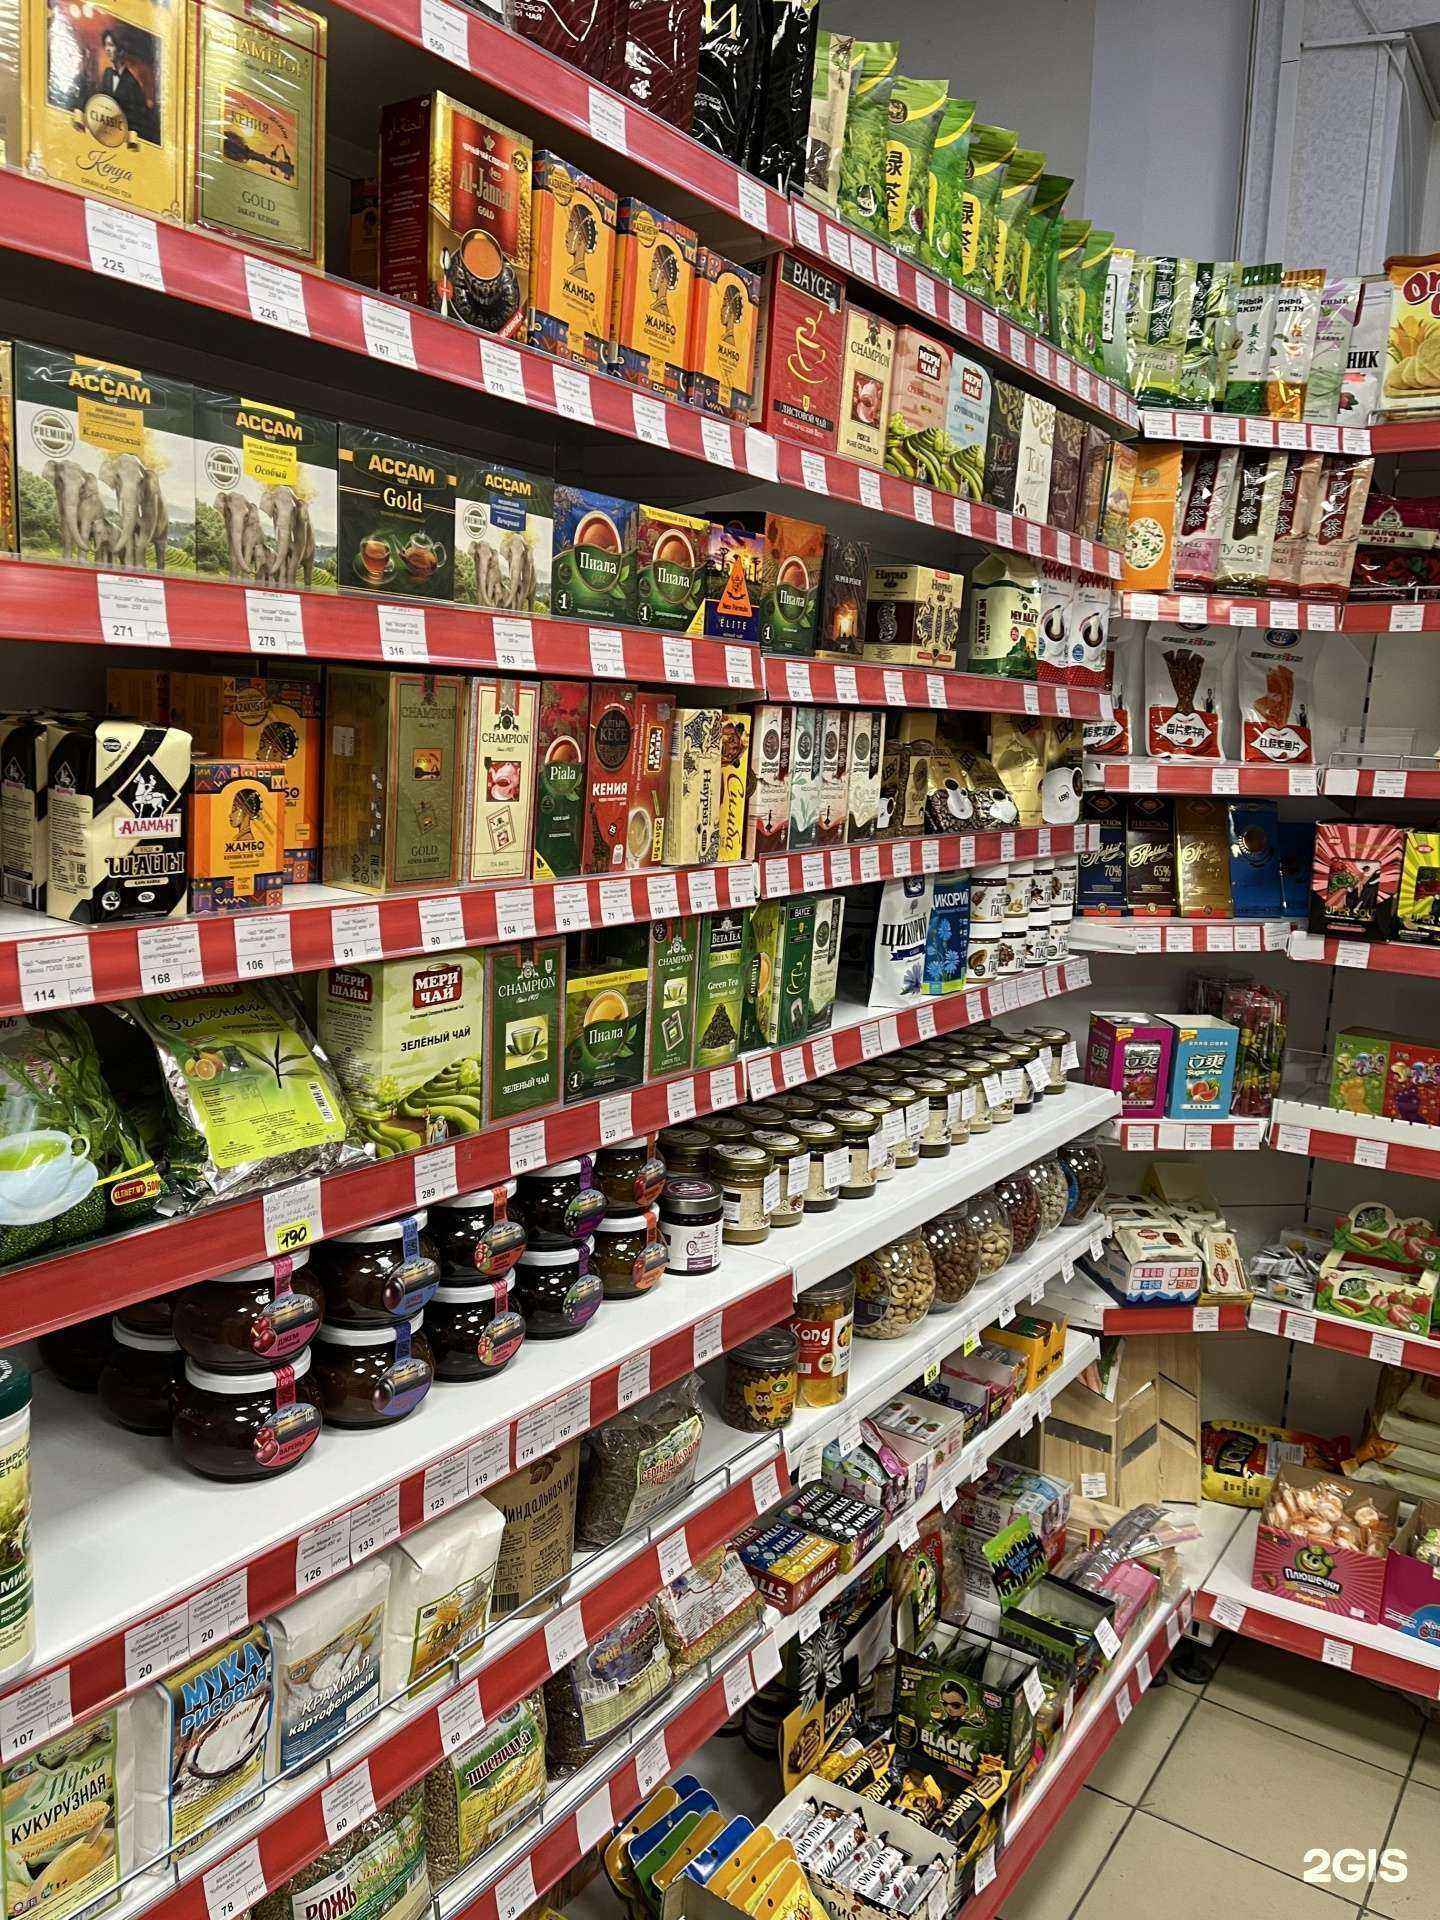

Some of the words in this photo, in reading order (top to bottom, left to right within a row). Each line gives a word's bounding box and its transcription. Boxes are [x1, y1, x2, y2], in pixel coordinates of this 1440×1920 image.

[76, 150, 135, 182] Kenya
[242, 190, 275, 213] GOLD
[101, 256, 126, 274] 225
[793, 263, 833, 299] BAYCE
[562, 278, 596, 303] ЖАМБО
[258, 306, 279, 321] 226
[645, 313, 677, 337] ЖАМБО
[850, 341, 890, 369] CHAMPION
[34, 425, 73, 440] PREMIUM
[207, 460, 239, 475] PREMIUM
[254, 464, 287, 480] Особый
[383, 486, 423, 513] Gold
[579, 551, 617, 576] Пиала
[657, 567, 690, 587] Пиала
[112, 625, 134, 638] 271
[720, 617, 747, 630] ELITE
[258, 635, 276, 647] 278
[389, 646, 404, 656] 316
[481, 732, 529, 744] CHAMPION
[550, 765, 576, 781] Piala
[592, 782, 628, 796] КЕНИЯ
[119, 817, 176, 834] АЛАМАН
[224, 840, 265, 852] ЖАМБО
[411, 845, 438, 857] GOLD
[503, 924, 516, 935] 104
[562, 918, 571, 927] 95
[431, 936, 441, 945] 90
[343, 948, 354, 958] 91
[657, 953, 693, 967] CHAMPION
[246, 959, 263, 970] 106
[151, 973, 171, 985] 168
[334, 973, 366, 988] МЕРИ
[414, 971, 459, 991] МЕРИ
[498, 976, 556, 998] CHAMPION
[707, 980, 727, 991] Green
[728, 978, 740, 988] Tea
[33, 989, 56, 1002] 114
[420, 984, 454, 1005] ЧАЙ
[452, 1025, 471, 1039] ЧАЙ
[588, 1026, 623, 1044] Пиала
[515, 1159, 527, 1168] 178
[421, 1188, 436, 1199] 289
[281, 1226, 307, 1248] 190
[622, 1391, 633, 1402] 167
[559, 1426, 571, 1437] 167
[521, 1448, 534, 1460] 174
[475, 1474, 488, 1486] 119
[430, 1498, 445, 1511] 123
[799, 1486, 821, 1507] HALLS
[809, 1491, 835, 1512] HALLS
[825, 1496, 850, 1518] HALLS
[839, 1502, 865, 1523] HALLS
[853, 1507, 879, 1529] HALLS
[756, 1522, 785, 1546] HALLS
[772, 1529, 800, 1552] HALLS
[358, 1537, 374, 1553] 133
[787, 1535, 815, 1558] HALLS
[801, 1542, 830, 1565] HALLS
[304, 1566, 322, 1582] 126
[750, 1574, 787, 1600] ALLS
[201, 1628, 214, 1643] 20
[138, 1663, 152, 1679] 20
[181, 1642, 264, 1714] МУКА
[301, 1655, 371, 1716] КРАХМАЛ
[180, 1664, 267, 1737] РИСОВАЯ
[289, 1669, 374, 1737] картофельный
[825, 1694, 856, 1734] ZEBRA
[12, 1729, 34, 1749] 107
[450, 1732, 461, 1744] 60
[920, 1728, 975, 1763] BLACK
[10, 1773, 107, 1846] КУКУРУЗНАЯ
[336, 1818, 348, 1831] 60
[221, 1902, 234, 1917] 78
[305, 1884, 357, 1920] РОЖЬ
